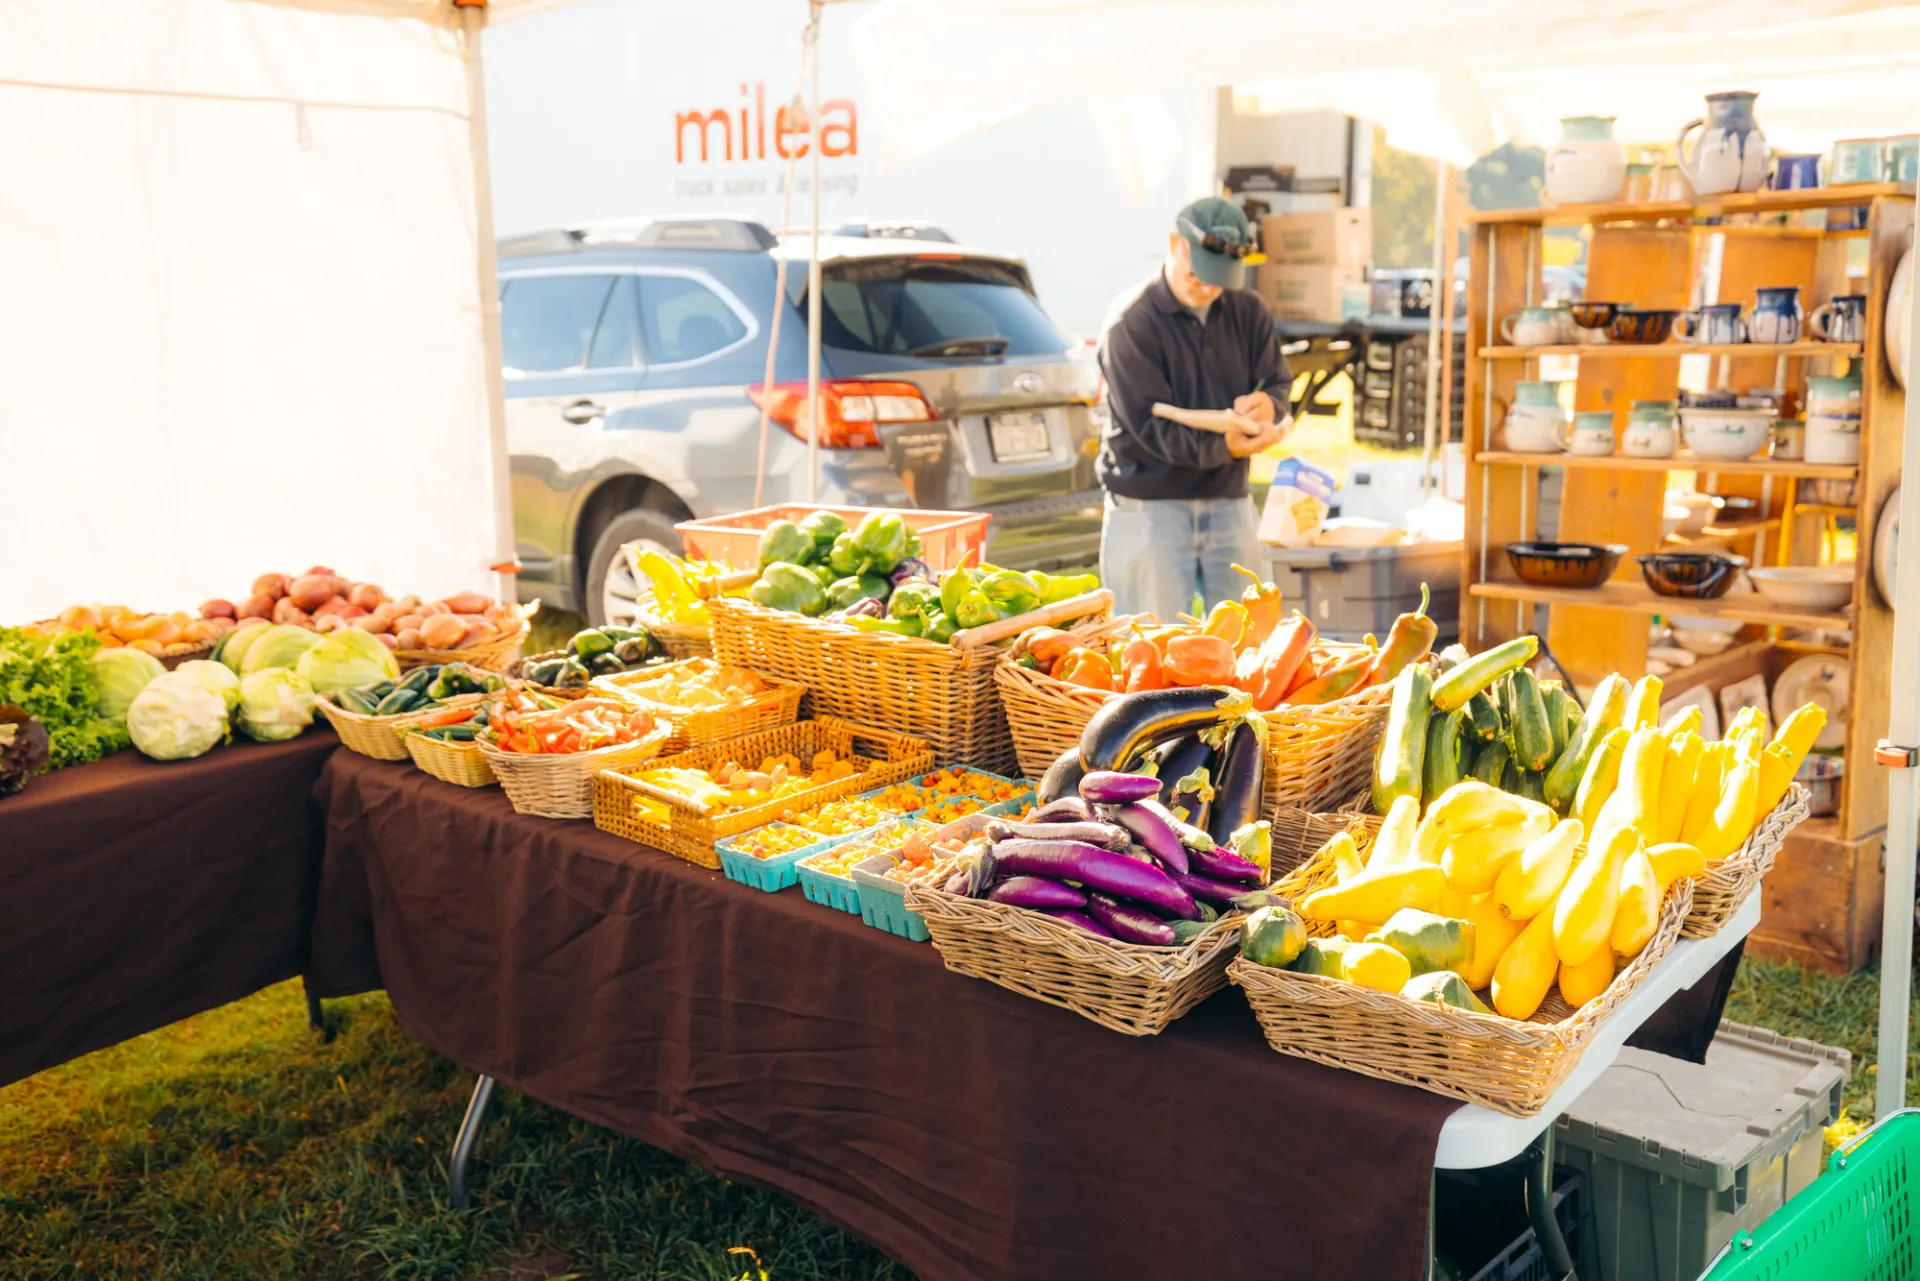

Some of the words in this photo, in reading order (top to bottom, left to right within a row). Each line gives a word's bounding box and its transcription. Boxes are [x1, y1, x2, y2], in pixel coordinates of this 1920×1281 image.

[675, 82, 858, 163] milea
[724, 174, 767, 195] sales
[795, 172, 858, 196] lesing
